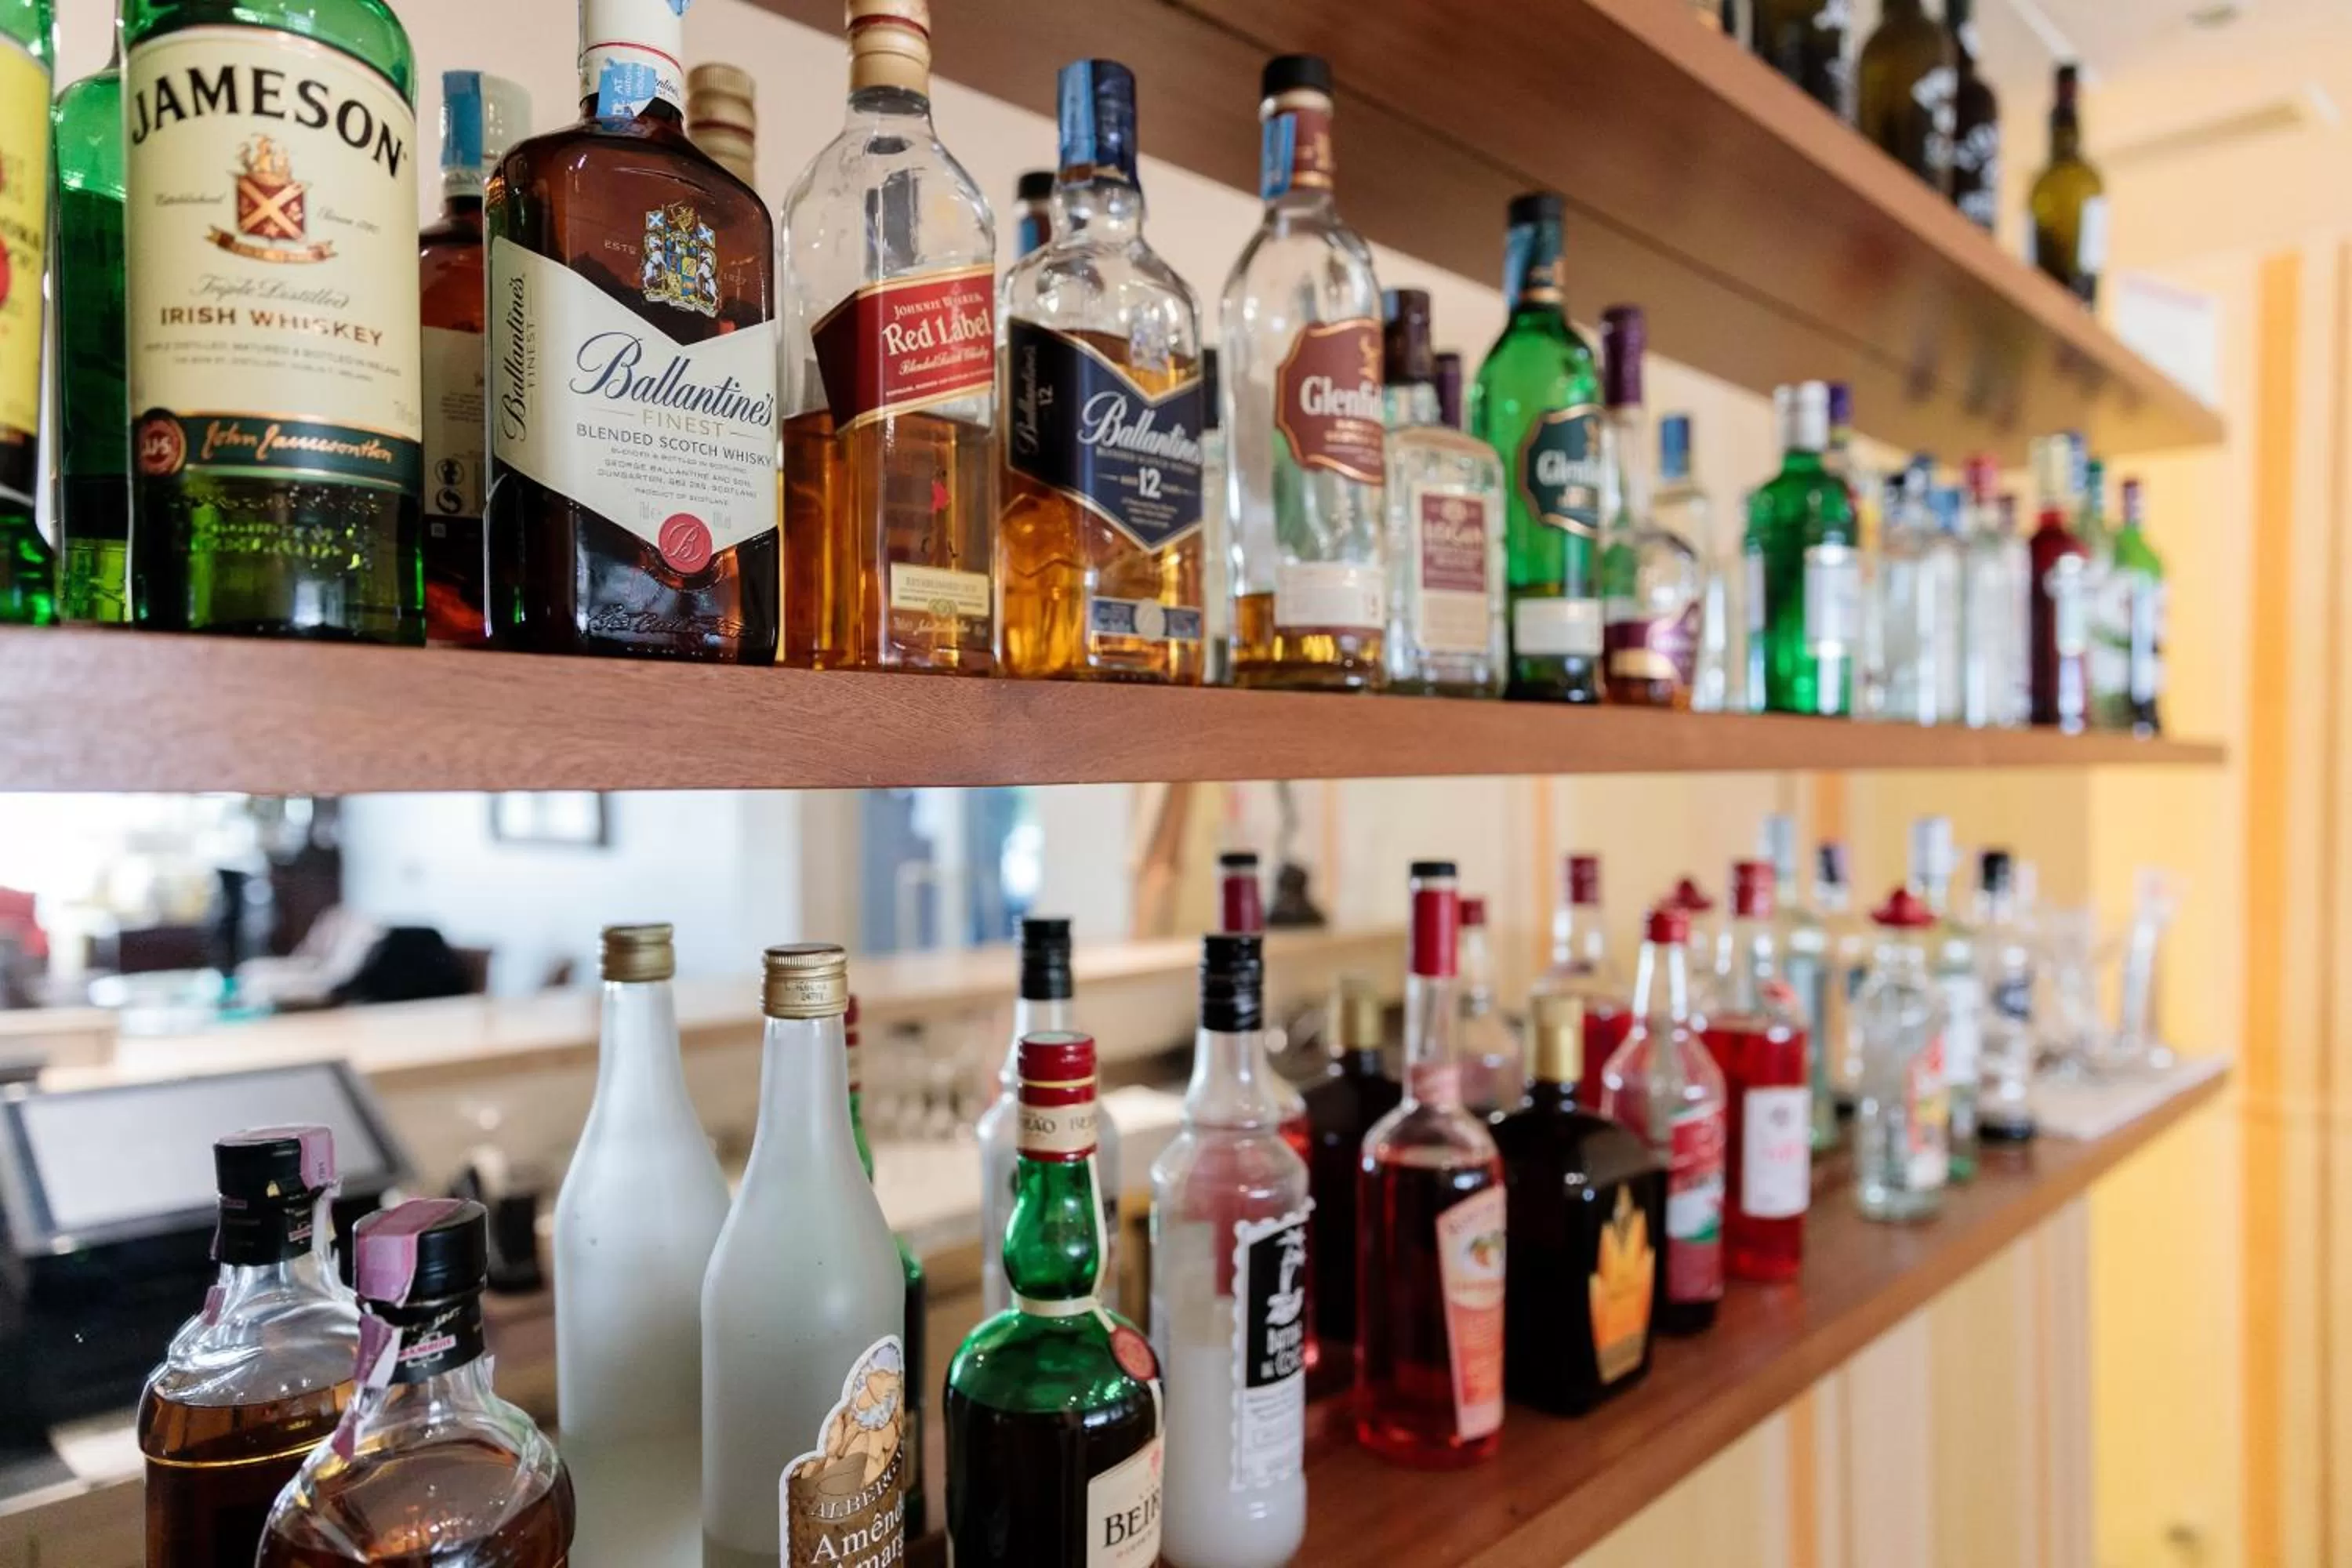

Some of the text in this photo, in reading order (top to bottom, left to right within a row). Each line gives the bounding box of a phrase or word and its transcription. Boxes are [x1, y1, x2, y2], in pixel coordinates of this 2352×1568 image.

[132, 65, 403, 178] JAMESON
[160, 307, 383, 347] IRISH WHISKEY
[882, 307, 992, 356] Red Label
[501, 277, 526, 442] Ballantine's
[569, 331, 775, 427] Ballantine's
[201, 420, 257, 460] John
[576, 423, 772, 468] BLENDED SCOTCH WHISKY
[642, 408, 725, 438] FINEST
[1138, 466, 1162, 500] 12
